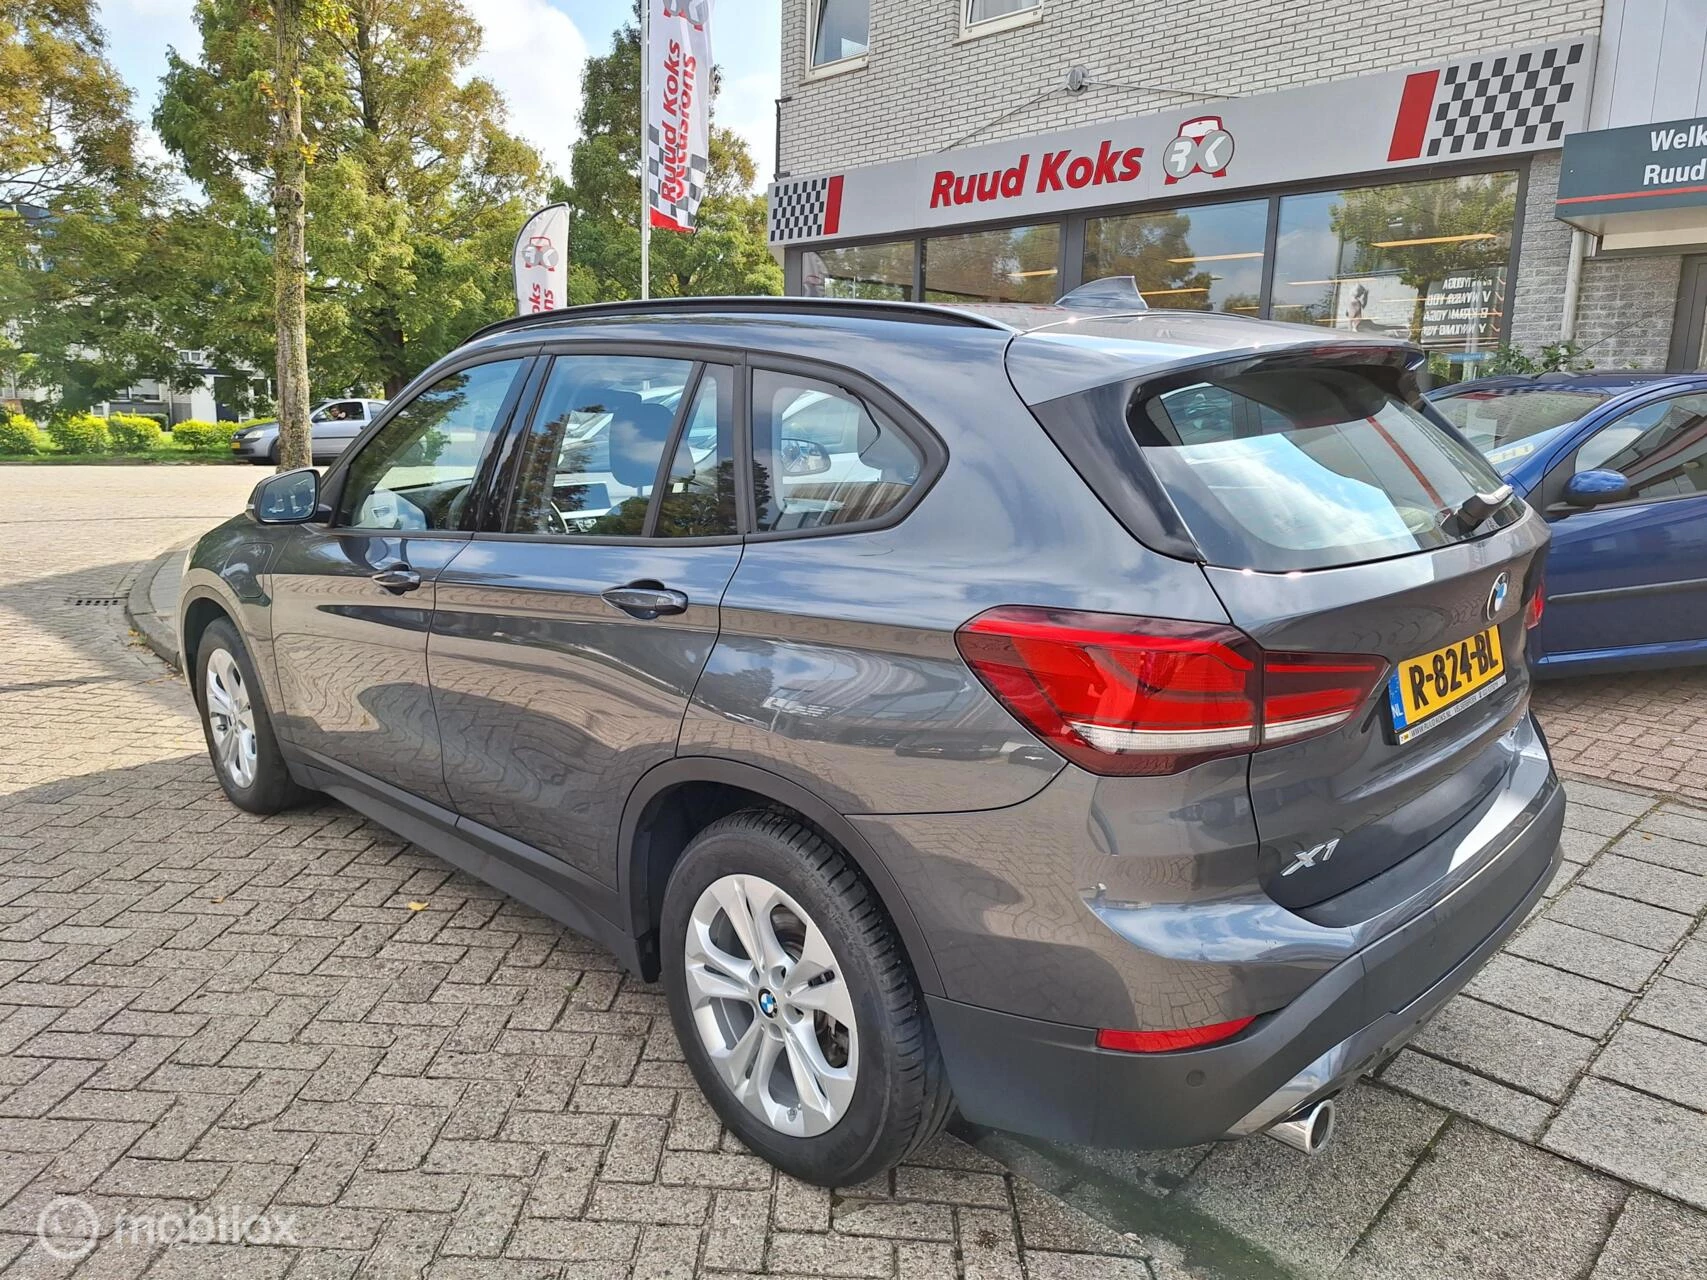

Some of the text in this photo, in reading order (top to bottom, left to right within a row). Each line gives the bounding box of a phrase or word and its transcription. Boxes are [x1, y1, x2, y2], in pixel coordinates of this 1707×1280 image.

[661, 39, 680, 203] Ruud Koks
[1651, 124, 1707, 151] Welk
[930, 140, 1144, 208] Ruud Koks
[1643, 158, 1707, 185] Ruud
[1409, 630, 1499, 711] R-824-BL
[1391, 704, 1404, 719] NL
[1281, 838, 1340, 876] X1
